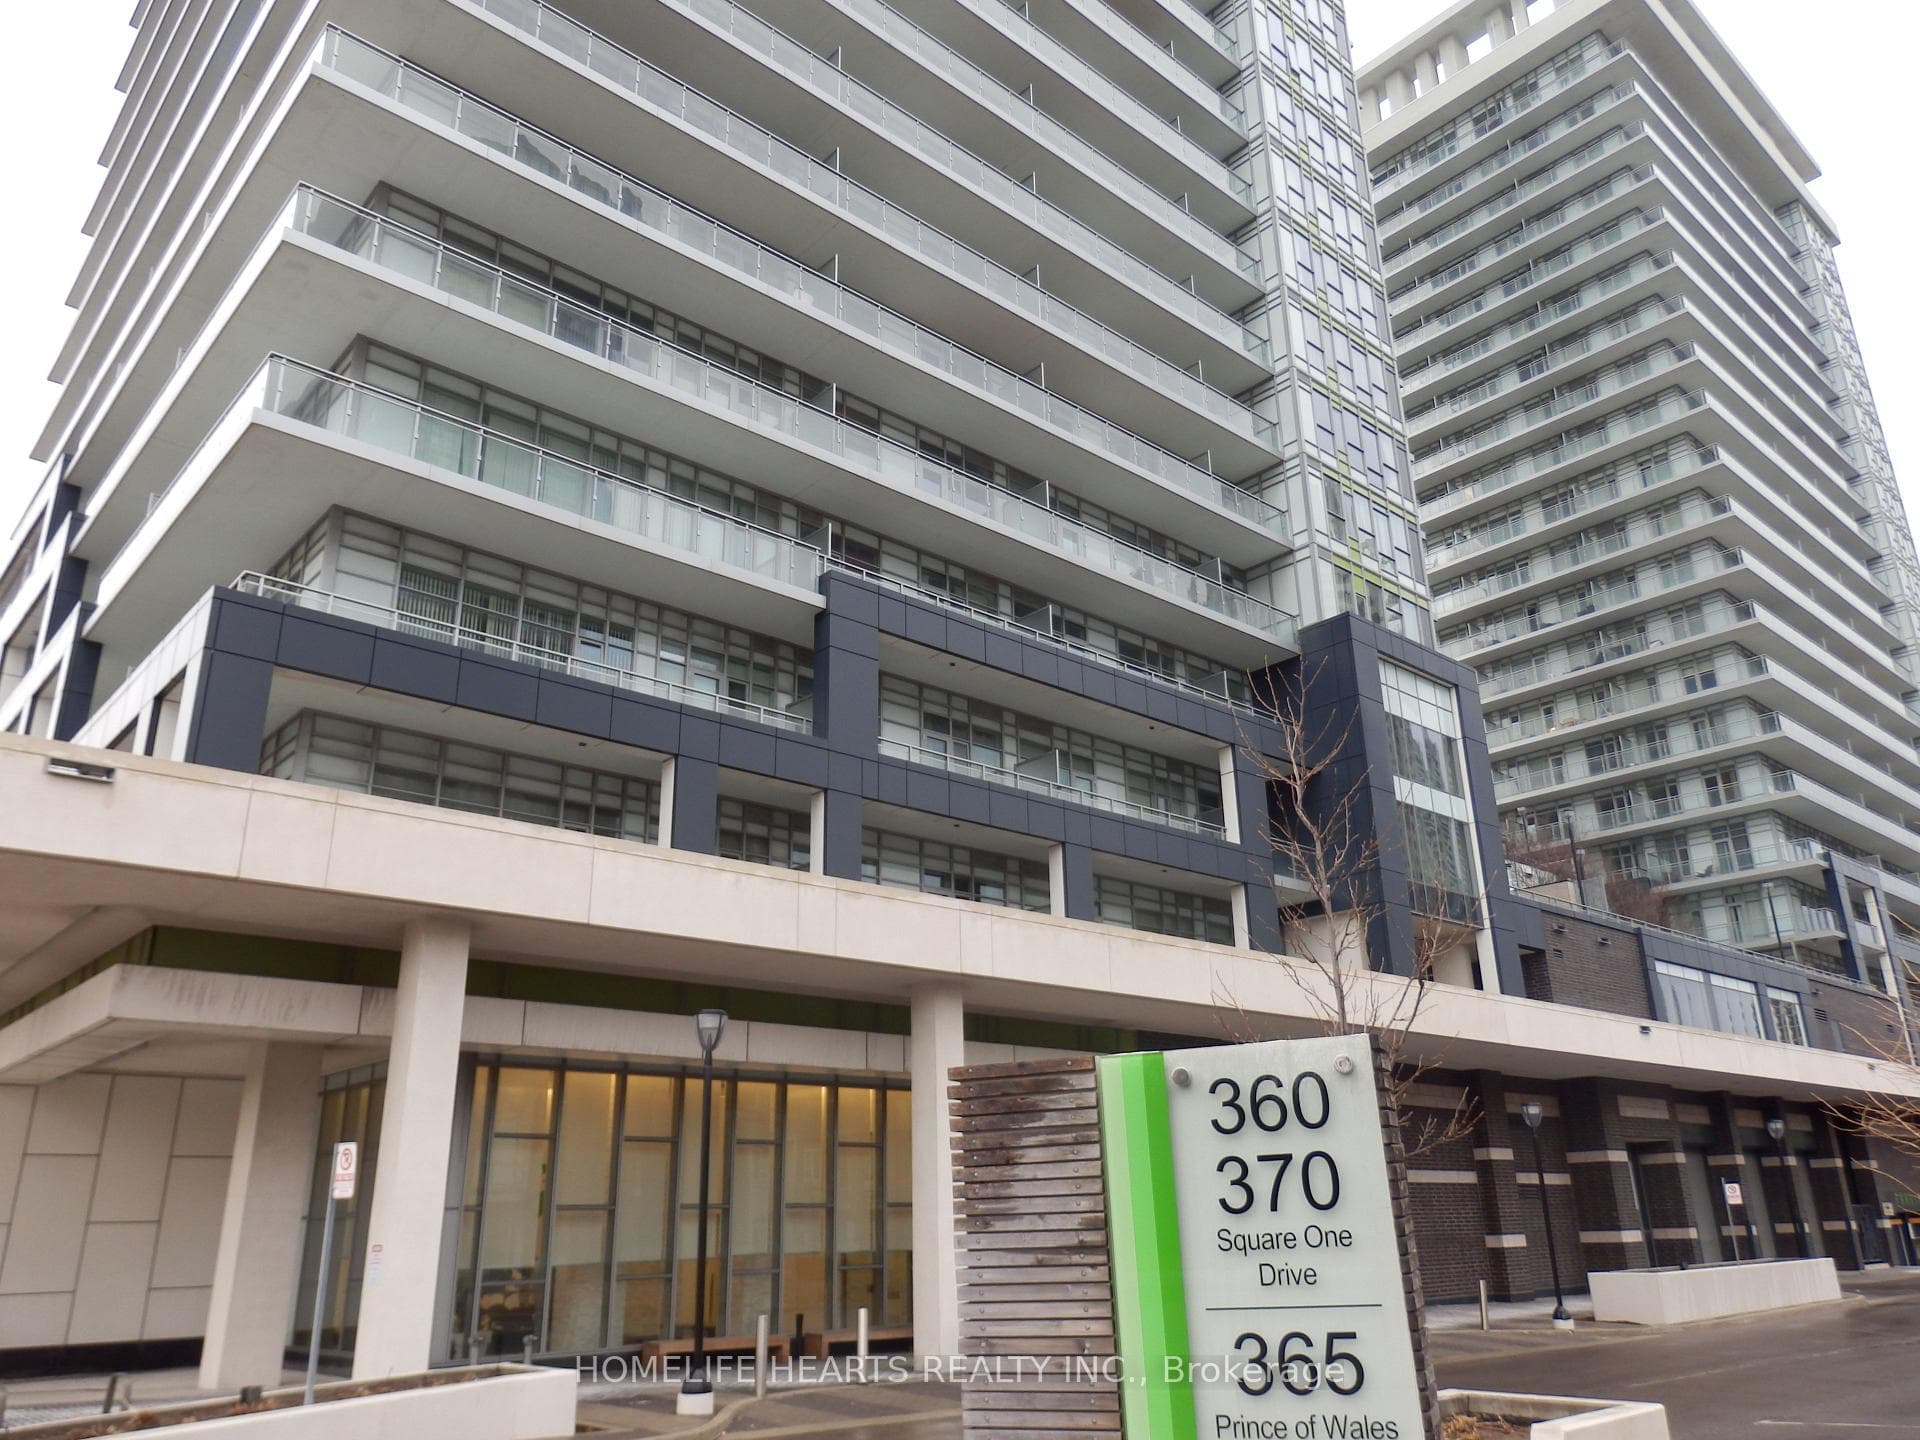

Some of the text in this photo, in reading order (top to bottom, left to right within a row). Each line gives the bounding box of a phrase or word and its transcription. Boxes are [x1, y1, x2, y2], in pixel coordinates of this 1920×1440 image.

[1208, 1071, 1330, 1135] 360
[1216, 1150, 1340, 1215] 370
[1217, 1225, 1353, 1256] Square One
[1259, 1262, 1317, 1286] Drive
[1233, 1331, 1365, 1397] 365
[1216, 1413, 1400, 1440] Prince of Wales
